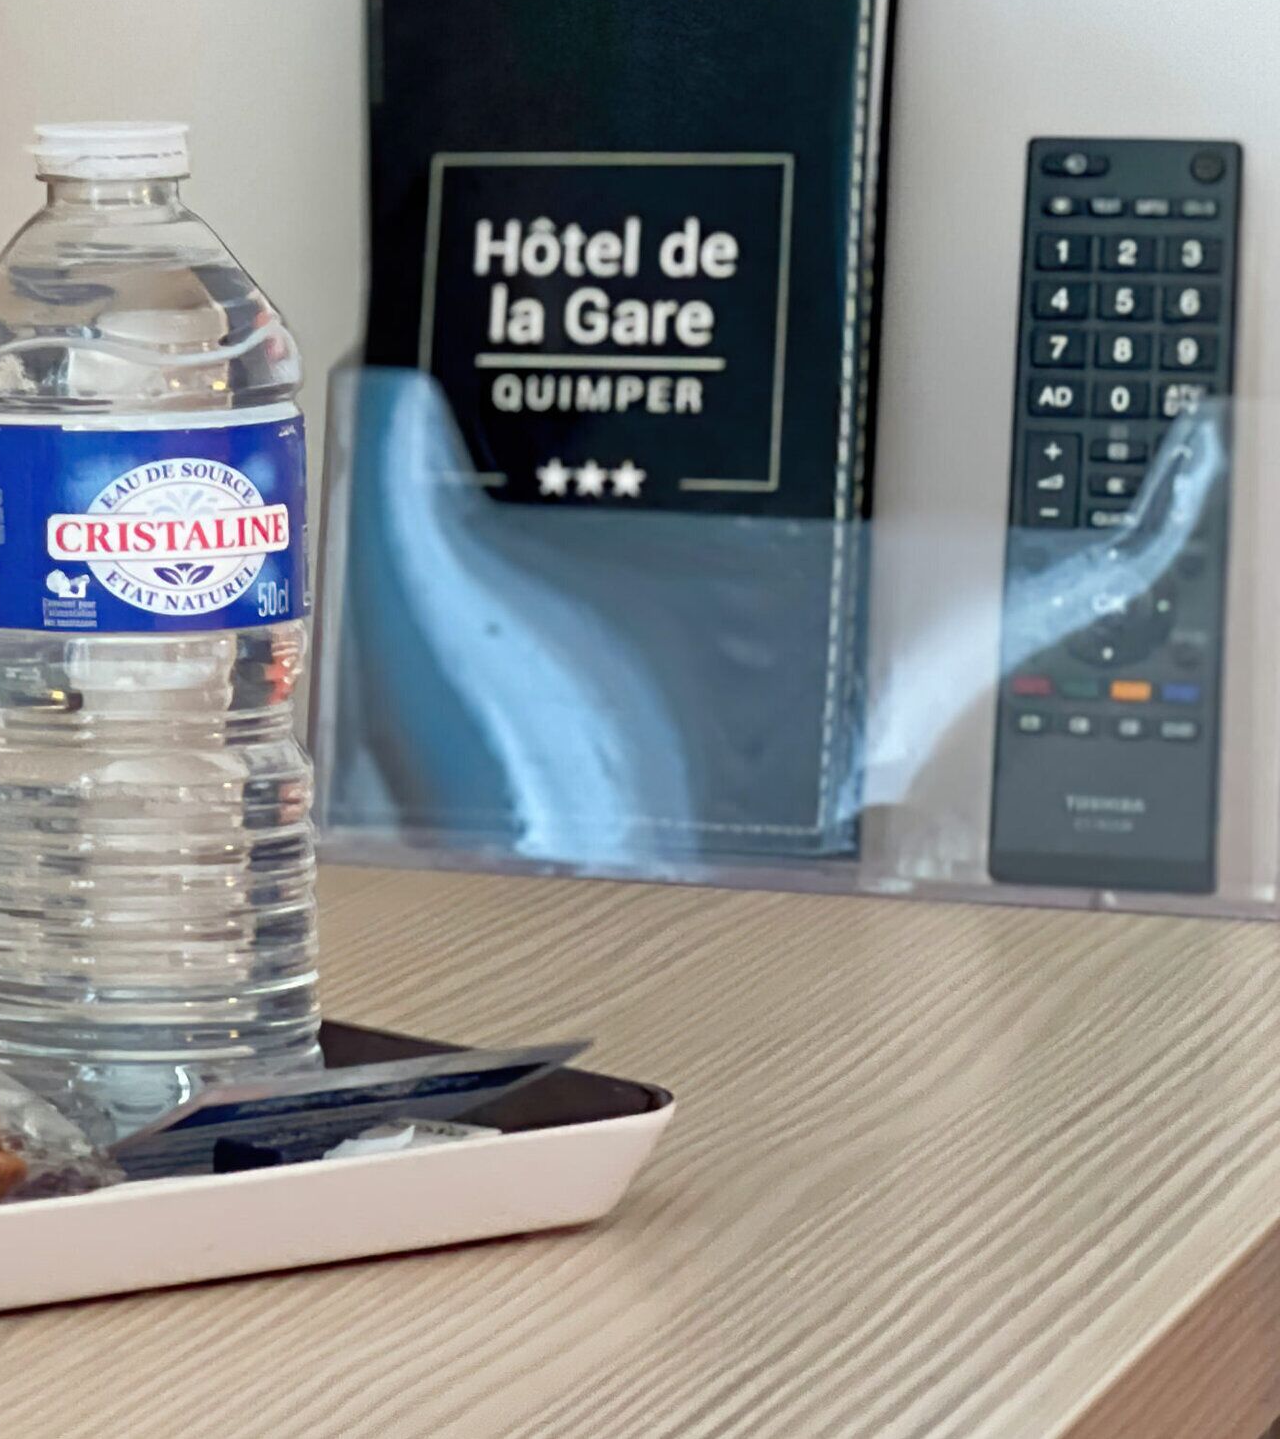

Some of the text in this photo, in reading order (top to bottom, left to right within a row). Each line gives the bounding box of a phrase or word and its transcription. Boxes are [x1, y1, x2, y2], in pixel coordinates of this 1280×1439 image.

[473, 216, 739, 279] Hôtel de
[1055, 239, 1203, 268] 1 2 3
[488, 282, 715, 347] la Gare
[1050, 287, 1201, 316] 4 5 6
[1049, 335, 1199, 366] 7 8 9
[491, 373, 703, 413] QUIMPER
[1038, 385, 1131, 413] AD 0
[100, 463, 256, 509] EAU DE SOURCE
[55, 512, 286, 553] CRISTALINE
[105, 571, 159, 607] ETAT
[166, 564, 256, 611] NATUREL
[258, 578, 289, 618] 50cl
